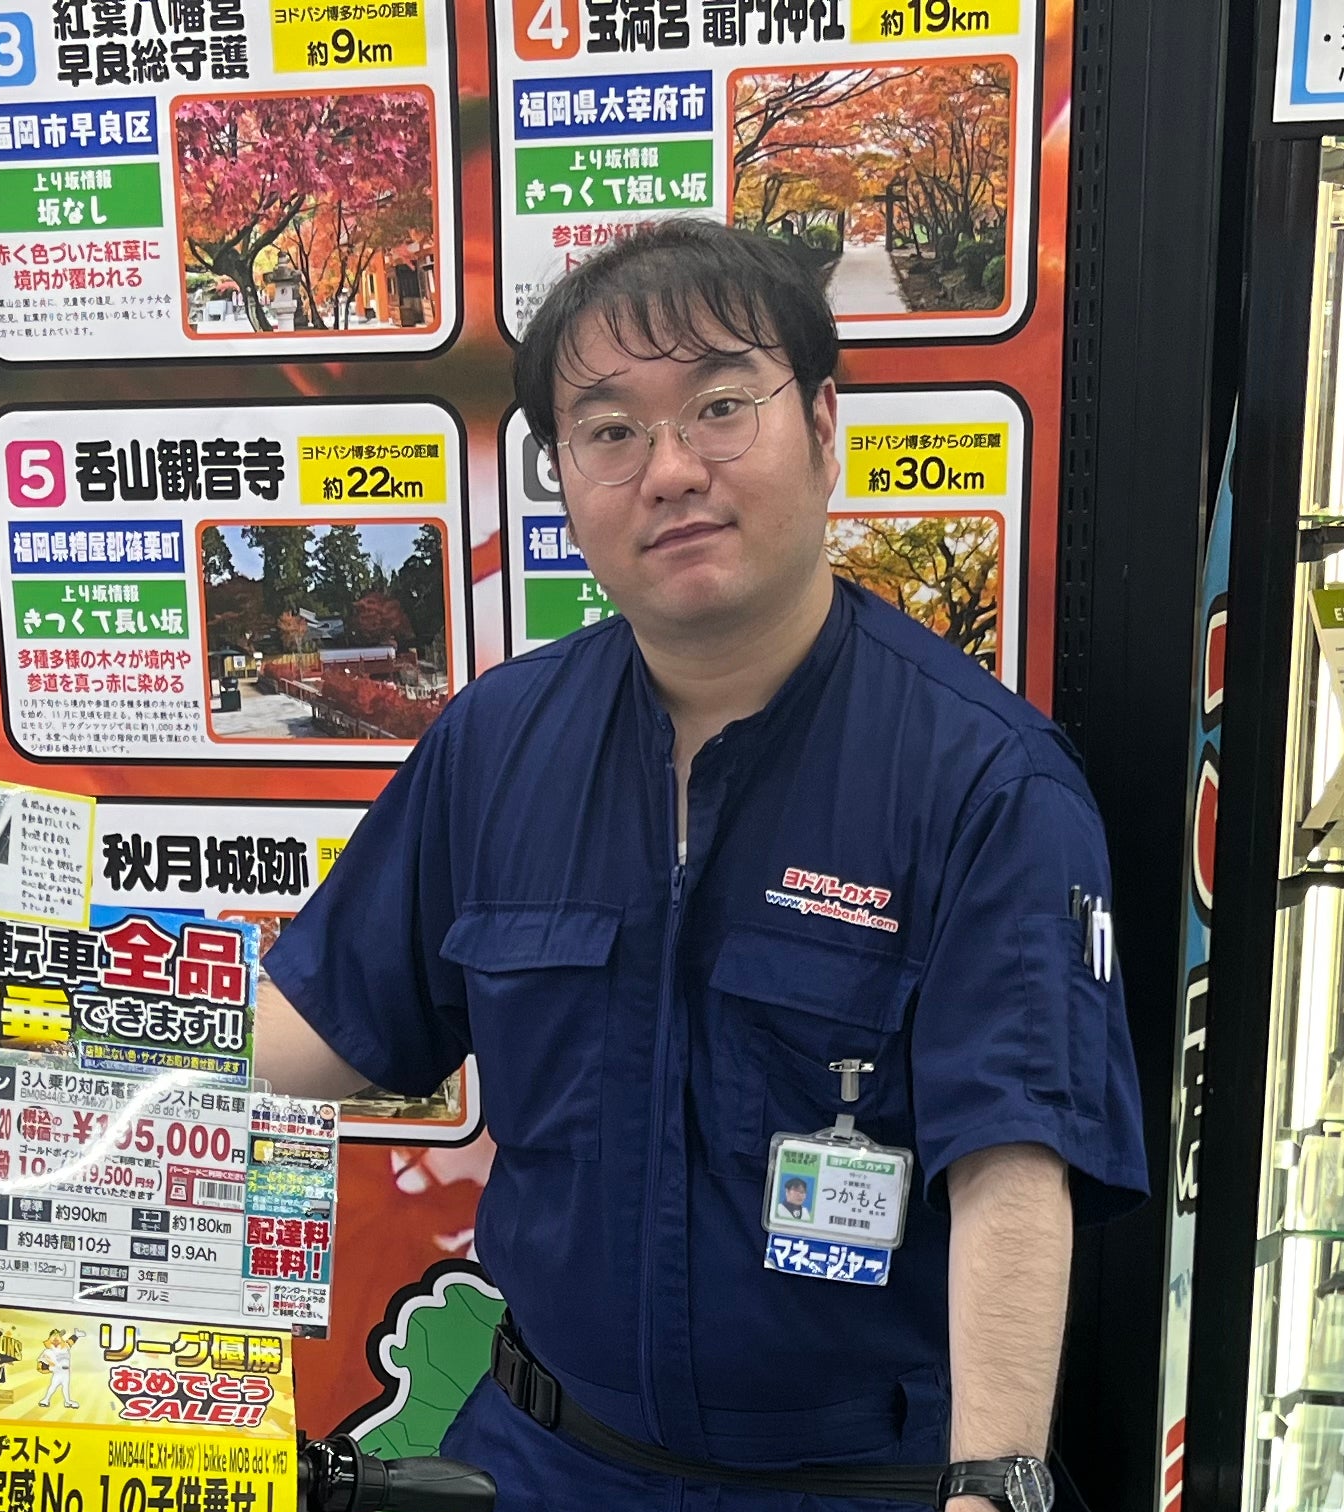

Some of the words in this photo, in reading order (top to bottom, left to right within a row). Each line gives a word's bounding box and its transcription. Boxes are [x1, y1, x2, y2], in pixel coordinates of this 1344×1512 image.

[275, 2, 419, 25] ヨドバシ博多からの距離
[527, 0, 570, 50] 4
[880, 0, 990, 38] 約19km
[57, 36, 251, 87] 早良総守護
[306, 29, 394, 68] 約9km
[518, 83, 707, 128] 福岡県太宰府市
[569, 147, 660, 170] 上り坂情報
[33, 172, 113, 191] 上り坂情報
[524, 172, 708, 210] きつくて短い坂
[37, 197, 109, 227] 坂なし
[14, 267, 143, 291] 境内が覆われる
[302, 443, 441, 462] ヨドバシ博多からの距離
[850, 432, 1002, 453] ヨドバシ博多からの距離
[18, 449, 56, 501] 5
[75, 437, 286, 504] 呑山観音寺
[322, 466, 424, 501] 約22km
[868, 456, 985, 492] 約30km
[61, 584, 140, 603] 上り坂情報
[23, 607, 185, 636] きつくて長い坂
[18, 649, 192, 671] 多種多様の木々が境内や
[27, 673, 186, 694] 参道を真っ赤に染める
[102, 832, 311, 896] 秋月城跡
[784, 866, 892, 910] ヨドバシカメラ
[766, 889, 899, 934] www.yodobashi.com
[55, 1205, 108, 1224] 約90km
[171, 1215, 232, 1235] 約180km
[17, 1231, 112, 1254] 約4時間10分
[247, 1216, 331, 1251] 配達料
[171, 1245, 217, 1262] 9.9Ah
[251, 1246, 322, 1280] 無料!
[772, 1238, 885, 1280] マネージャー
[99, 1322, 283, 1375] リーグ優勝
[110, 1365, 274, 1402] おめでとう
[119, 1398, 264, 1428] SALE!!
